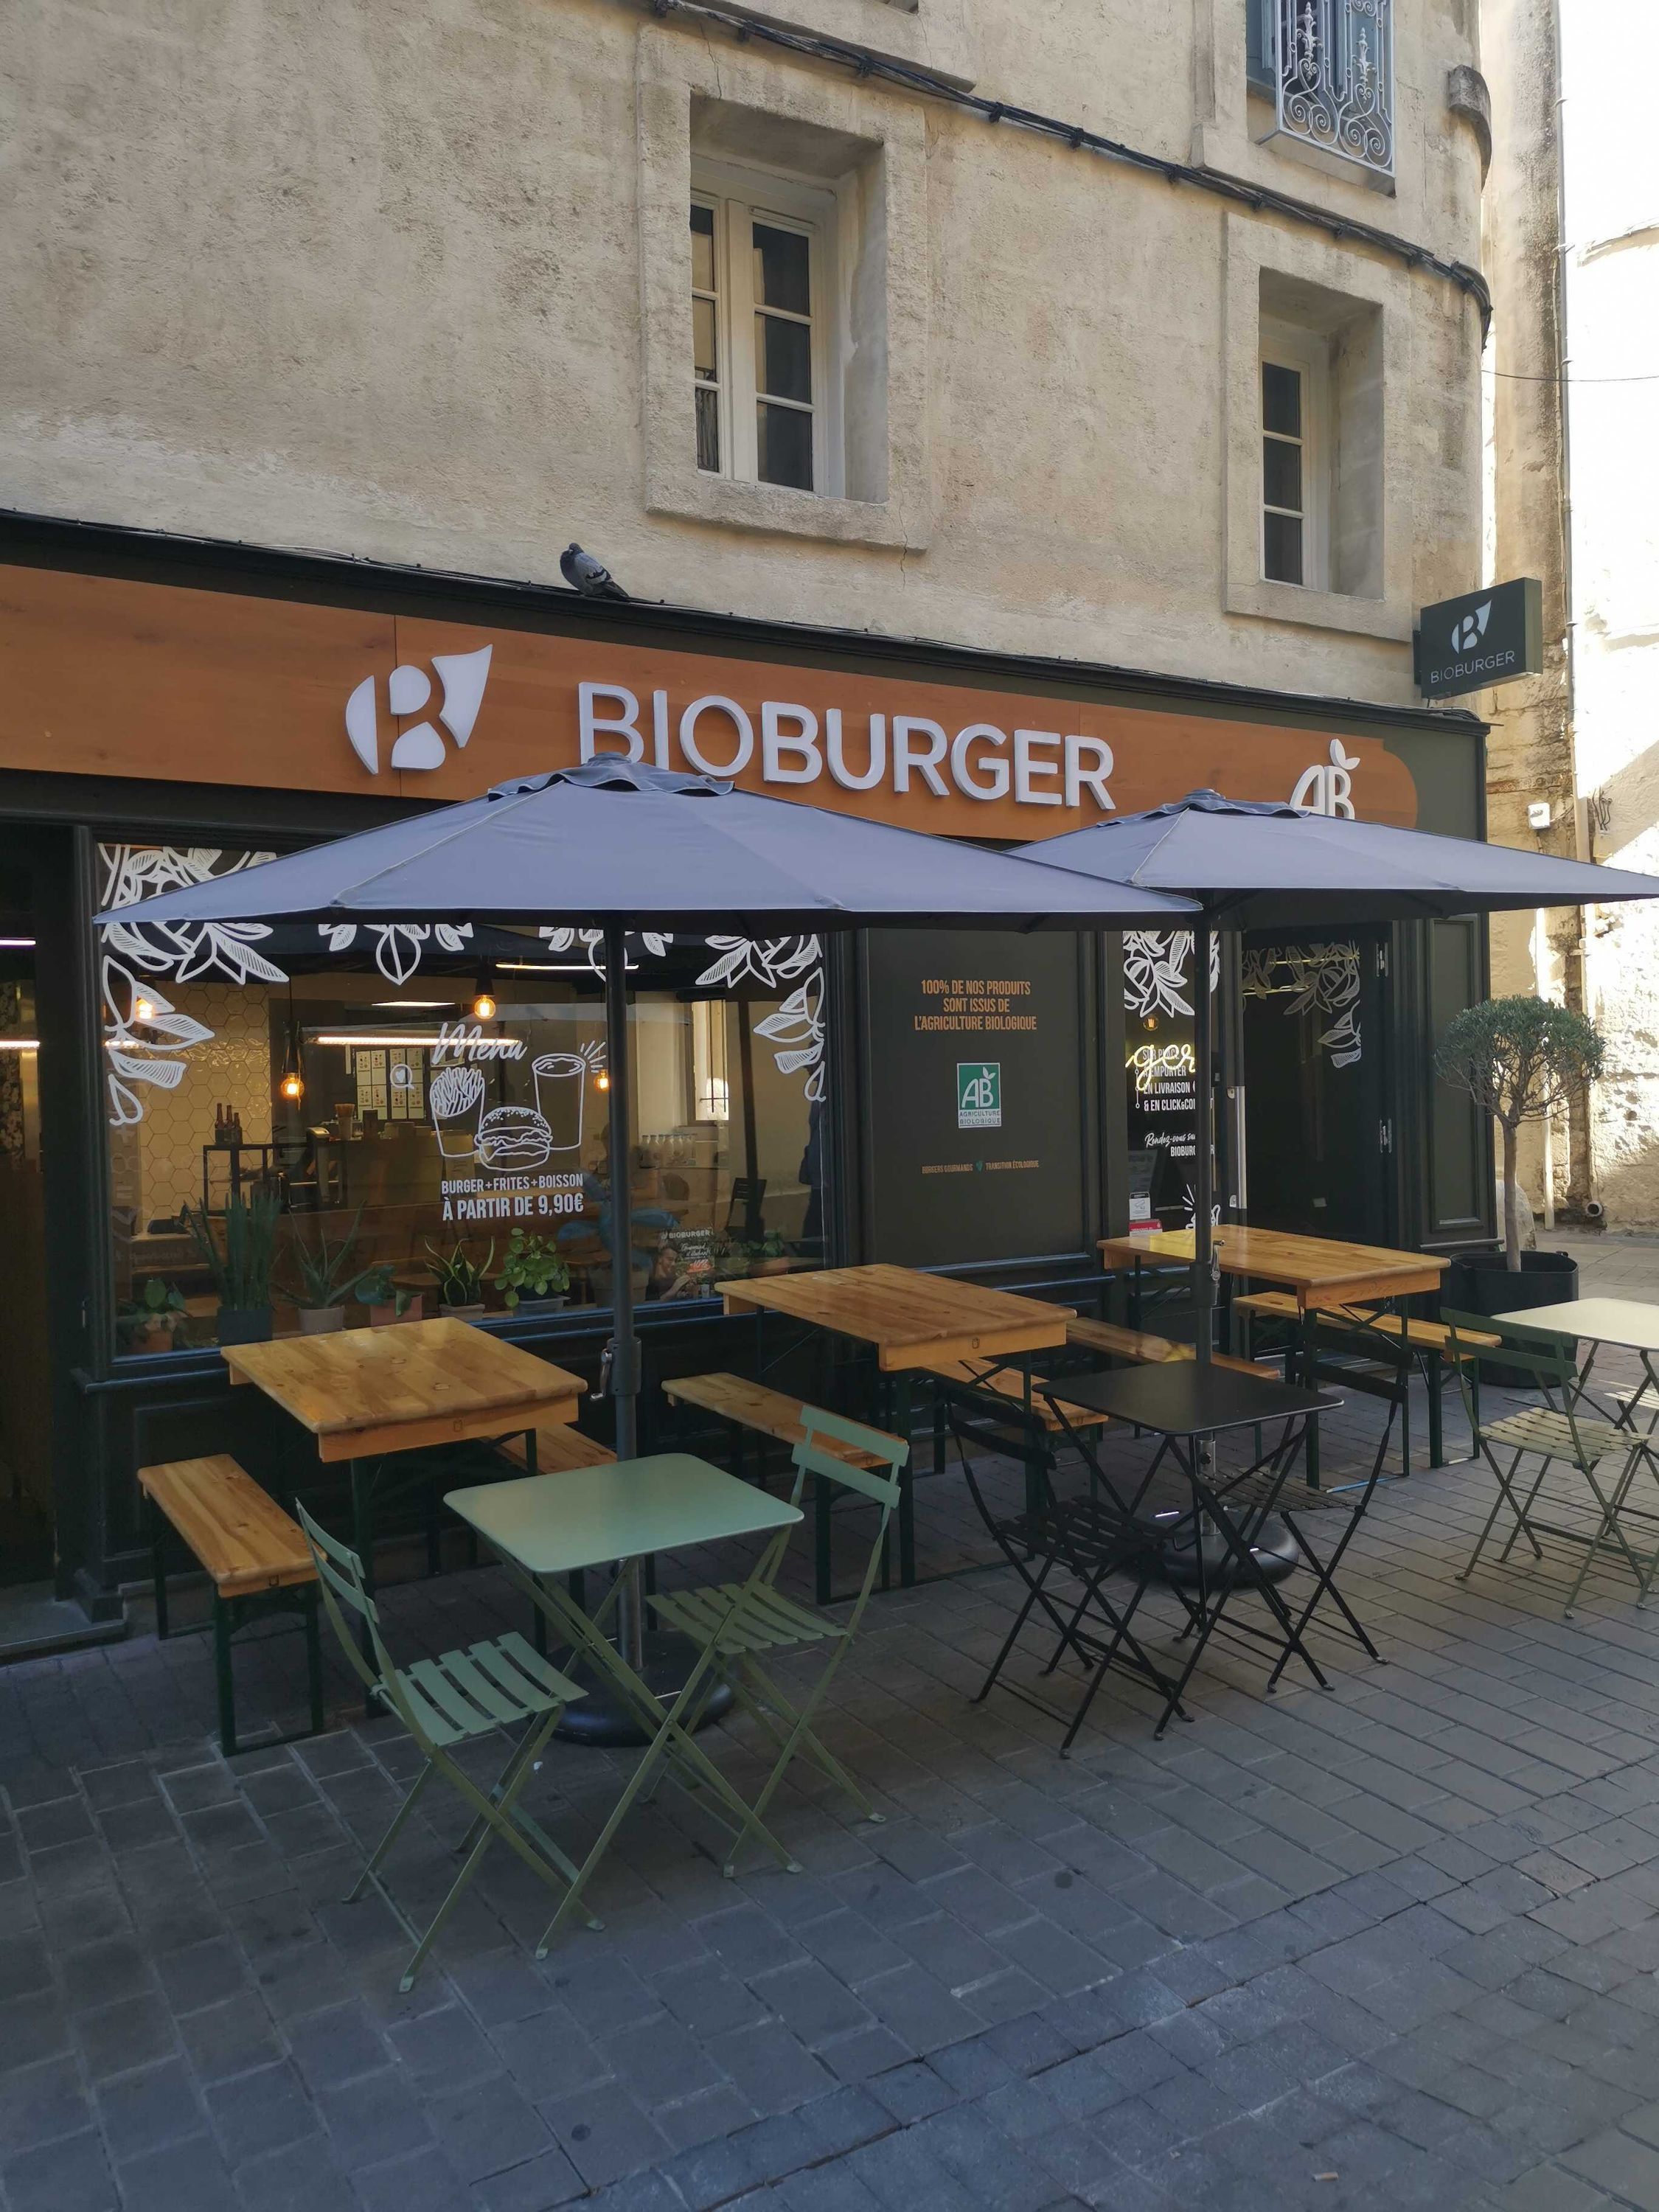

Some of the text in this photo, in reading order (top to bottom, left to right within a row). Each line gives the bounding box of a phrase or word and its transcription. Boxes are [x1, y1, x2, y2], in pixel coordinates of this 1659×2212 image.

[1430, 650, 1515, 684] BIOBURGER
[578, 681, 1116, 810] BIOBURGER
[1289, 765, 1355, 820] AB
[921, 979, 1031, 995] 100% DE NOS PRODUITS
[943, 998, 1010, 1012] SONT ISSUS DE
[914, 1015, 1037, 1031] L'AGRICULTURE BIOLOGIQUE
[431, 1022, 528, 1065] Menu
[961, 1078, 993, 1107] AB
[1155, 1082, 1190, 1094] LIVRAISON
[1144, 1100, 1150, 1111] &
[1150, 1099, 1161, 1111] EN
[1144, 1133, 1186, 1148] Rendez-vous
[442, 1192, 584, 1221] À PARTIR DE 9,90€
[669, 1229, 710, 1239] BIOBURGER
